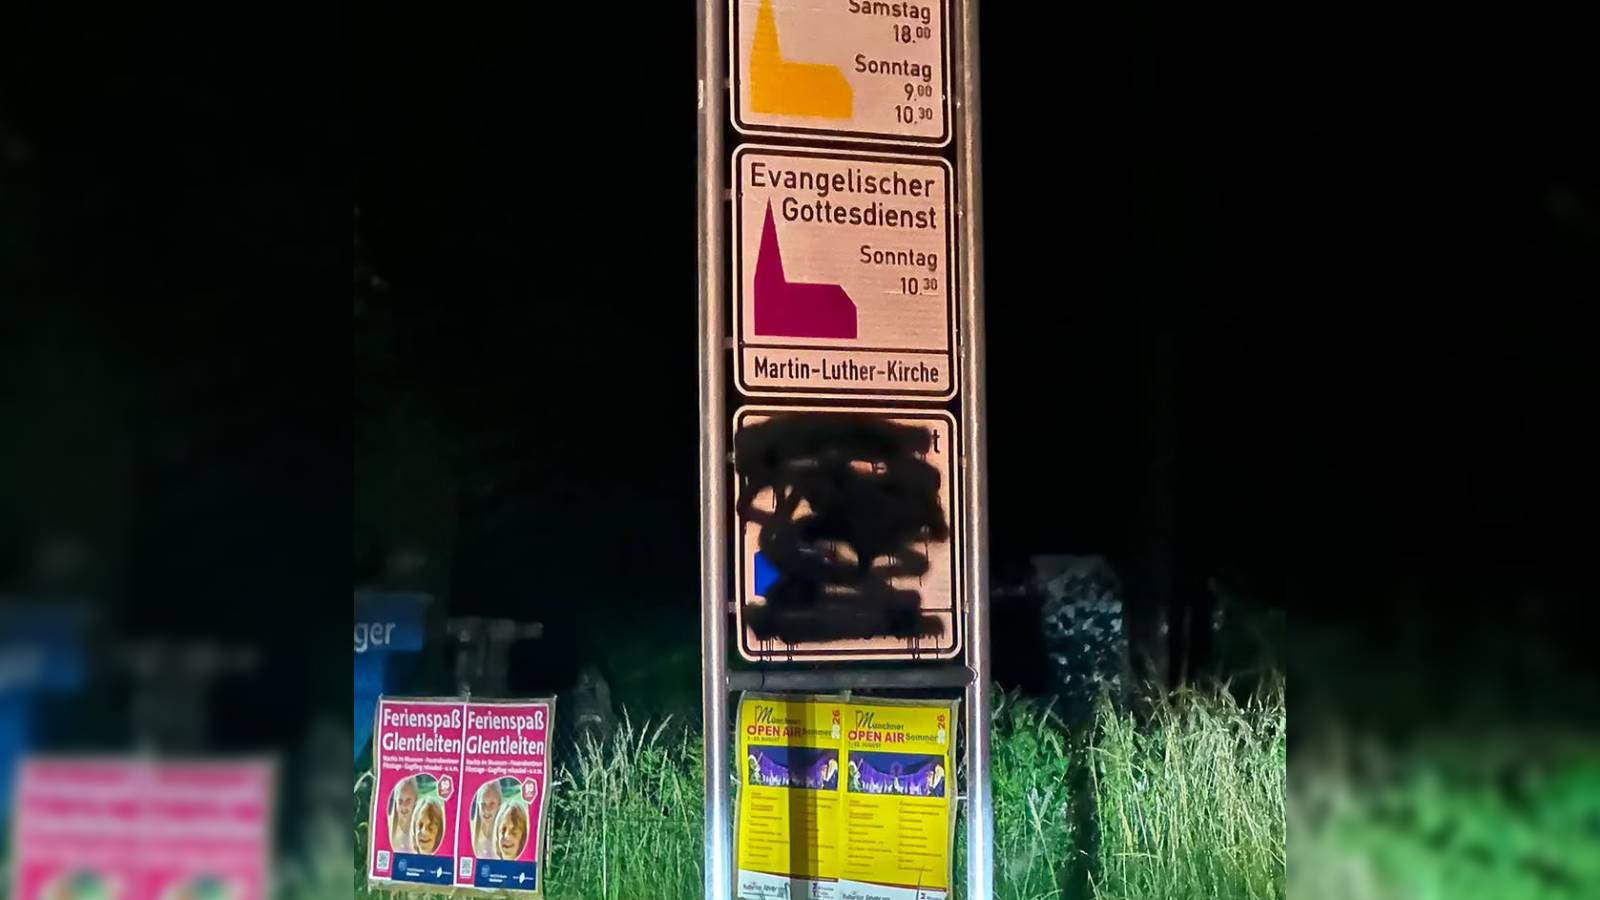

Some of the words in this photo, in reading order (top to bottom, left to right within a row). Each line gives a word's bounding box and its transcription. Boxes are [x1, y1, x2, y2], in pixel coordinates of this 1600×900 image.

[849, 0, 931, 24] Samstag
[855, 53, 932, 82] Sonntag
[750, 162, 935, 198] Evangelischer
[782, 196, 937, 229] Gottesdienst
[860, 244, 938, 271] Sonntag
[754, 355, 939, 384] Martin-Luther-Kirche
[383, 708, 461, 733] Ferienspaß
[468, 710, 544, 736] Ferienspaß
[747, 724, 780, 737] OPEN
[382, 733, 461, 754] Glentleiten
[466, 735, 544, 756] Glentleiten
[848, 730, 881, 742] OPEN
[885, 732, 905, 743] AIR
